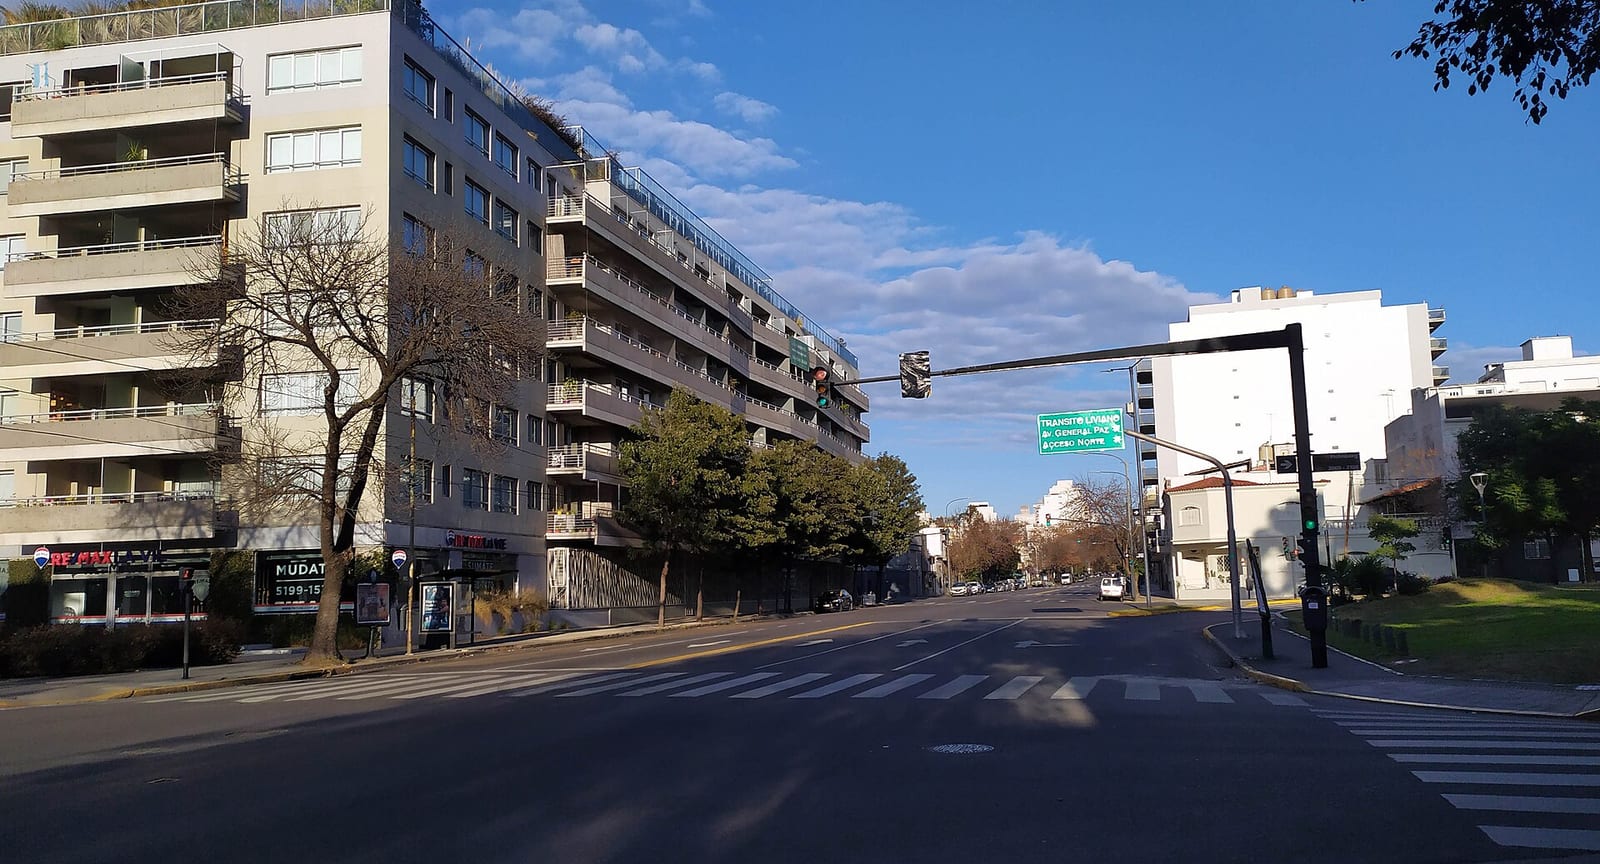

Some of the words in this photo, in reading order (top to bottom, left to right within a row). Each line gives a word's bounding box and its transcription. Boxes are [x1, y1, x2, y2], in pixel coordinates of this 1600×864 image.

[1085, 414, 1120, 424] LIVIANO
[1054, 428, 1092, 437] GENERAL
[1094, 426, 1109, 434] PAZ
[1043, 440, 1075, 449] ACCESO
[1077, 438, 1105, 446] NORTE
[51, 551, 112, 566] RE/MAX
[276, 564, 326, 576] MUDAT
[276, 586, 323, 596] 5199-15
